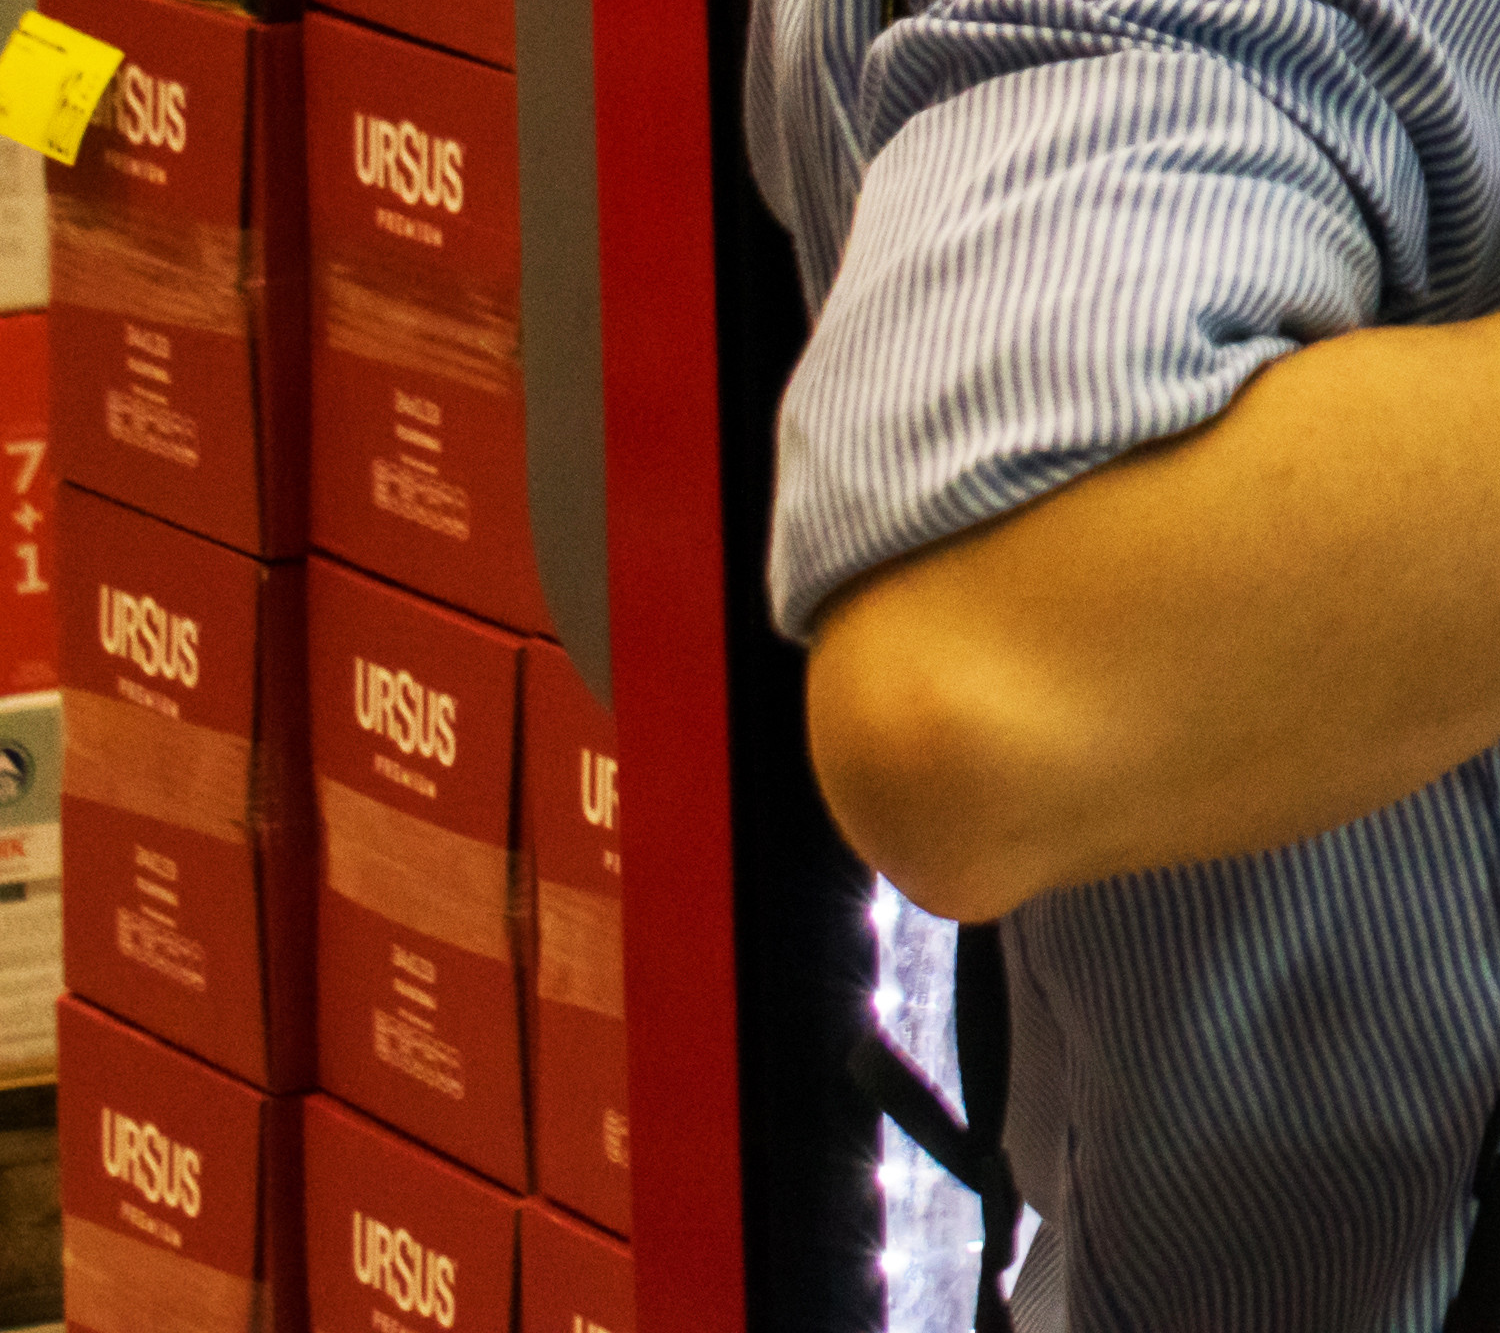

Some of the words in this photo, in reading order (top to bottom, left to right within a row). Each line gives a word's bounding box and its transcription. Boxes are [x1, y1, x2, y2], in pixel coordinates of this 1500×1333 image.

[353, 110, 465, 214] URSUS
[5, 440, 47, 494] 7
[15, 543, 49, 595] 1
[100, 584, 199, 689] URSUS
[354, 656, 457, 767] URSUS
[101, 1107, 200, 1218] URSUS
[352, 1210, 456, 1329] URSUS
